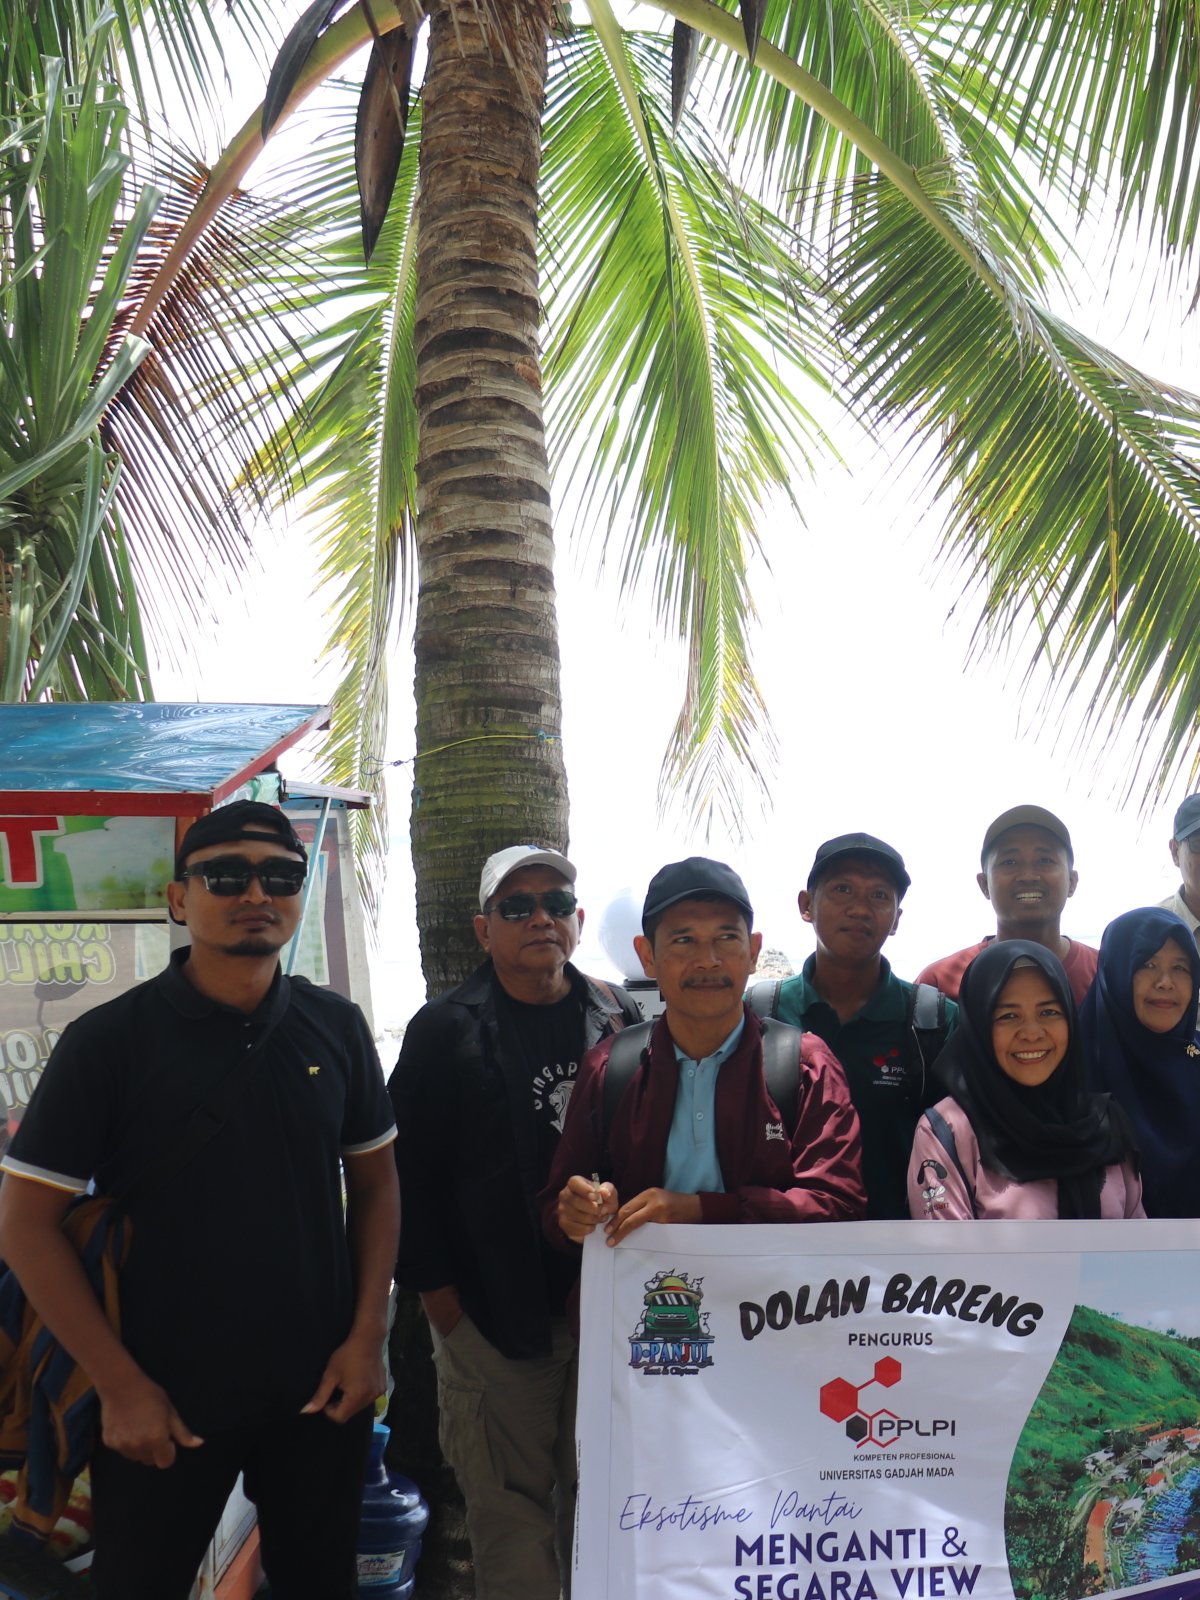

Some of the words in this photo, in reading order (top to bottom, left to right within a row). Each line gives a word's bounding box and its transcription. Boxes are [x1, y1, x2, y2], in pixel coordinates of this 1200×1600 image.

[891, 1066, 907, 1075] PPL
[533, 1062, 578, 1110] ingap
[739, 1275, 870, 1341] DOLAN
[882, 1273, 1044, 1337] BARENG
[848, 1332, 933, 1347] PENGURUS
[878, 1419, 956, 1437] PPLPI
[853, 1453, 897, 1462] KOMPETEN
[899, 1452, 956, 1461] PROFESIONAL
[819, 1468, 882, 1481] UNIVERSITAS
[884, 1467, 924, 1479] GADJAH
[926, 1466, 955, 1478] MADA
[619, 1493, 753, 1531] Eksotisme
[770, 1489, 863, 1529] Pantai
[735, 1528, 927, 1567] MENGANTI
[941, 1526, 968, 1557] &
[733, 1568, 878, 1600] SEGARA
[890, 1564, 982, 1599] VIEW
